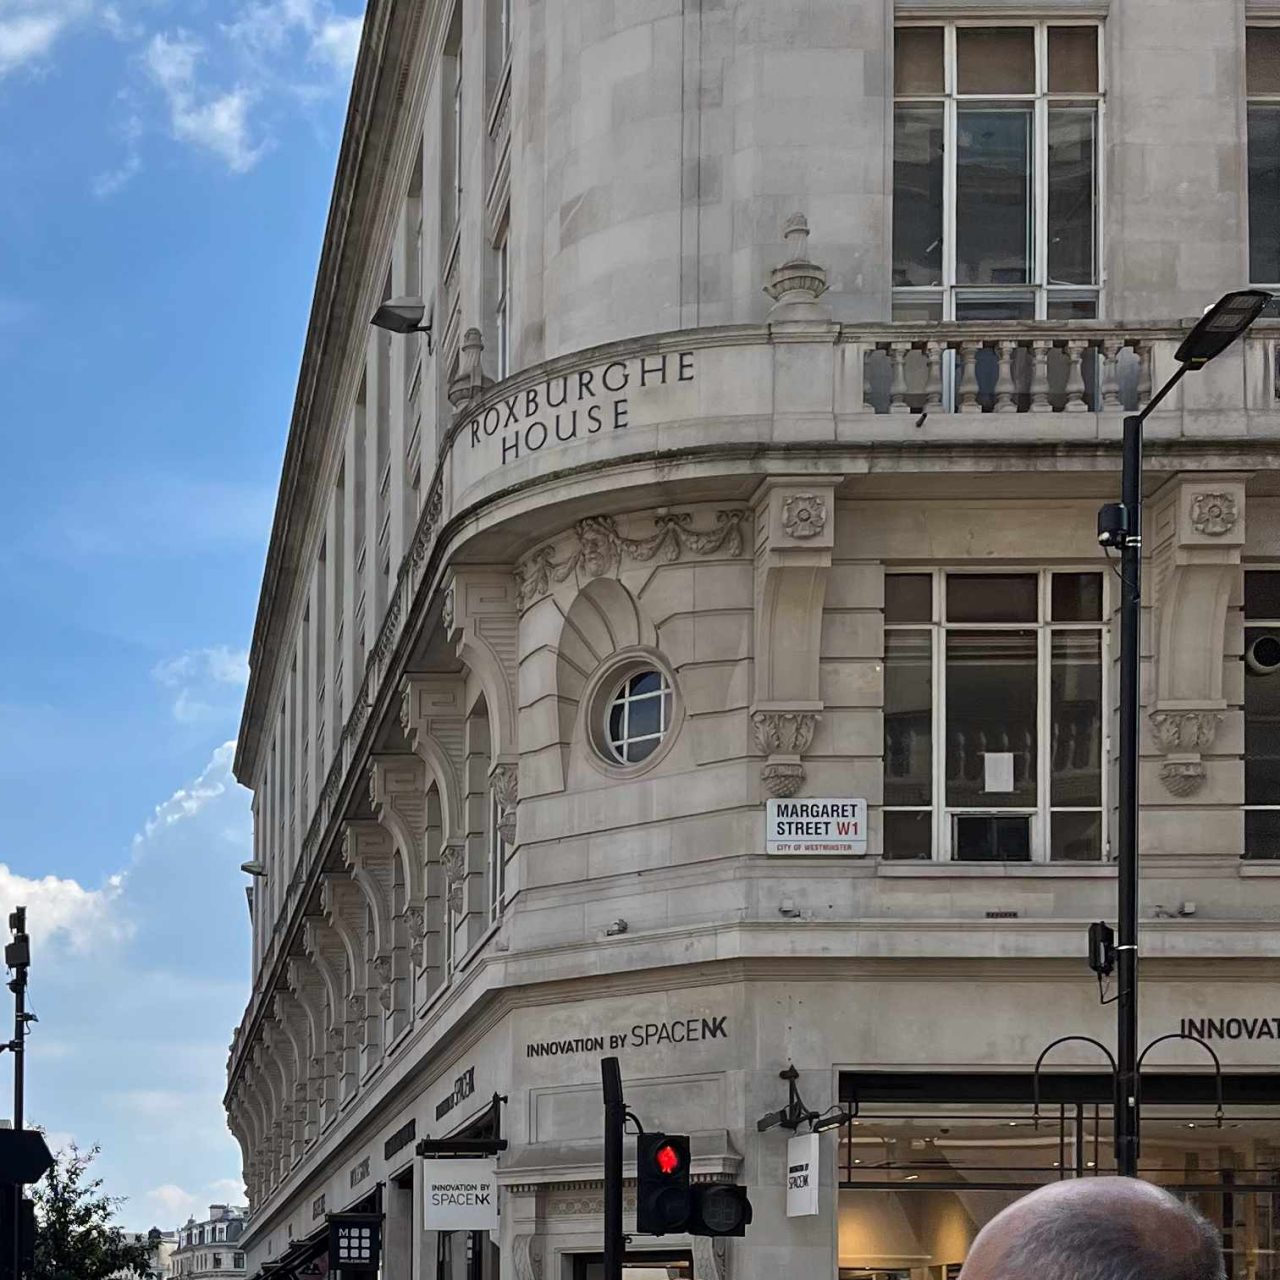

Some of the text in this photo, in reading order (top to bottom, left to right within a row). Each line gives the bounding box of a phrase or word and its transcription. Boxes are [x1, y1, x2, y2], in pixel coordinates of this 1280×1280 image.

[470, 351, 695, 448] ROXBURGHE
[501, 398, 629, 465] HOUSE
[776, 803, 858, 818] MARGARET
[776, 821, 859, 836] STREET W1
[776, 843, 852, 851] CITY OF WESTMINSTER
[526, 1036, 604, 1057] INNOVATION
[609, 1034, 628, 1049] BY
[431, 1184, 477, 1192] INNOVATION
